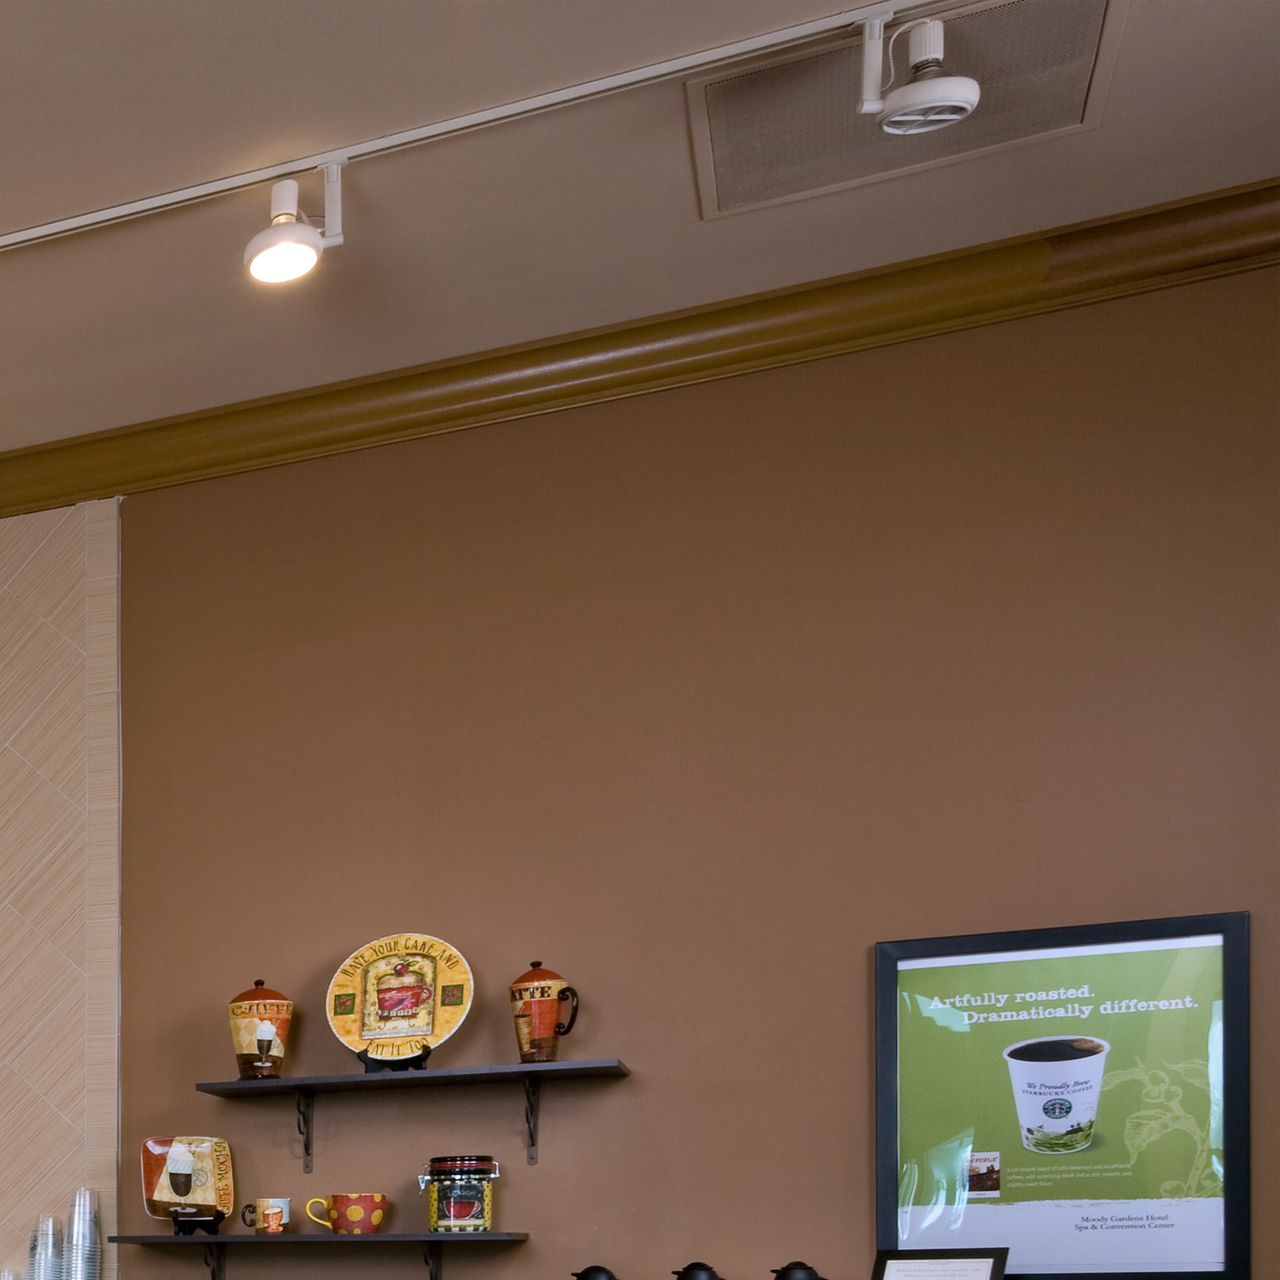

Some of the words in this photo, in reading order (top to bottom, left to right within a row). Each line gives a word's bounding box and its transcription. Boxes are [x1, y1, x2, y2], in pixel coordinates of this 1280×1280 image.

[341, 953, 369, 978] HAVE
[370, 939, 400, 957] YOUR
[405, 937, 436, 957] CAKE
[435, 949, 459, 970] AND
[928, 991, 1008, 1011] Artfully
[1014, 985, 1095, 1003] roasted.
[963, 1003, 1093, 1025] Dramatically
[1099, 994, 1198, 1015] different.
[366, 1039, 386, 1056] EAT
[391, 1043, 402, 1056] IT
[1039, 1081, 1070, 1090] Proudly
[1074, 1224, 1089, 1232] Spa
